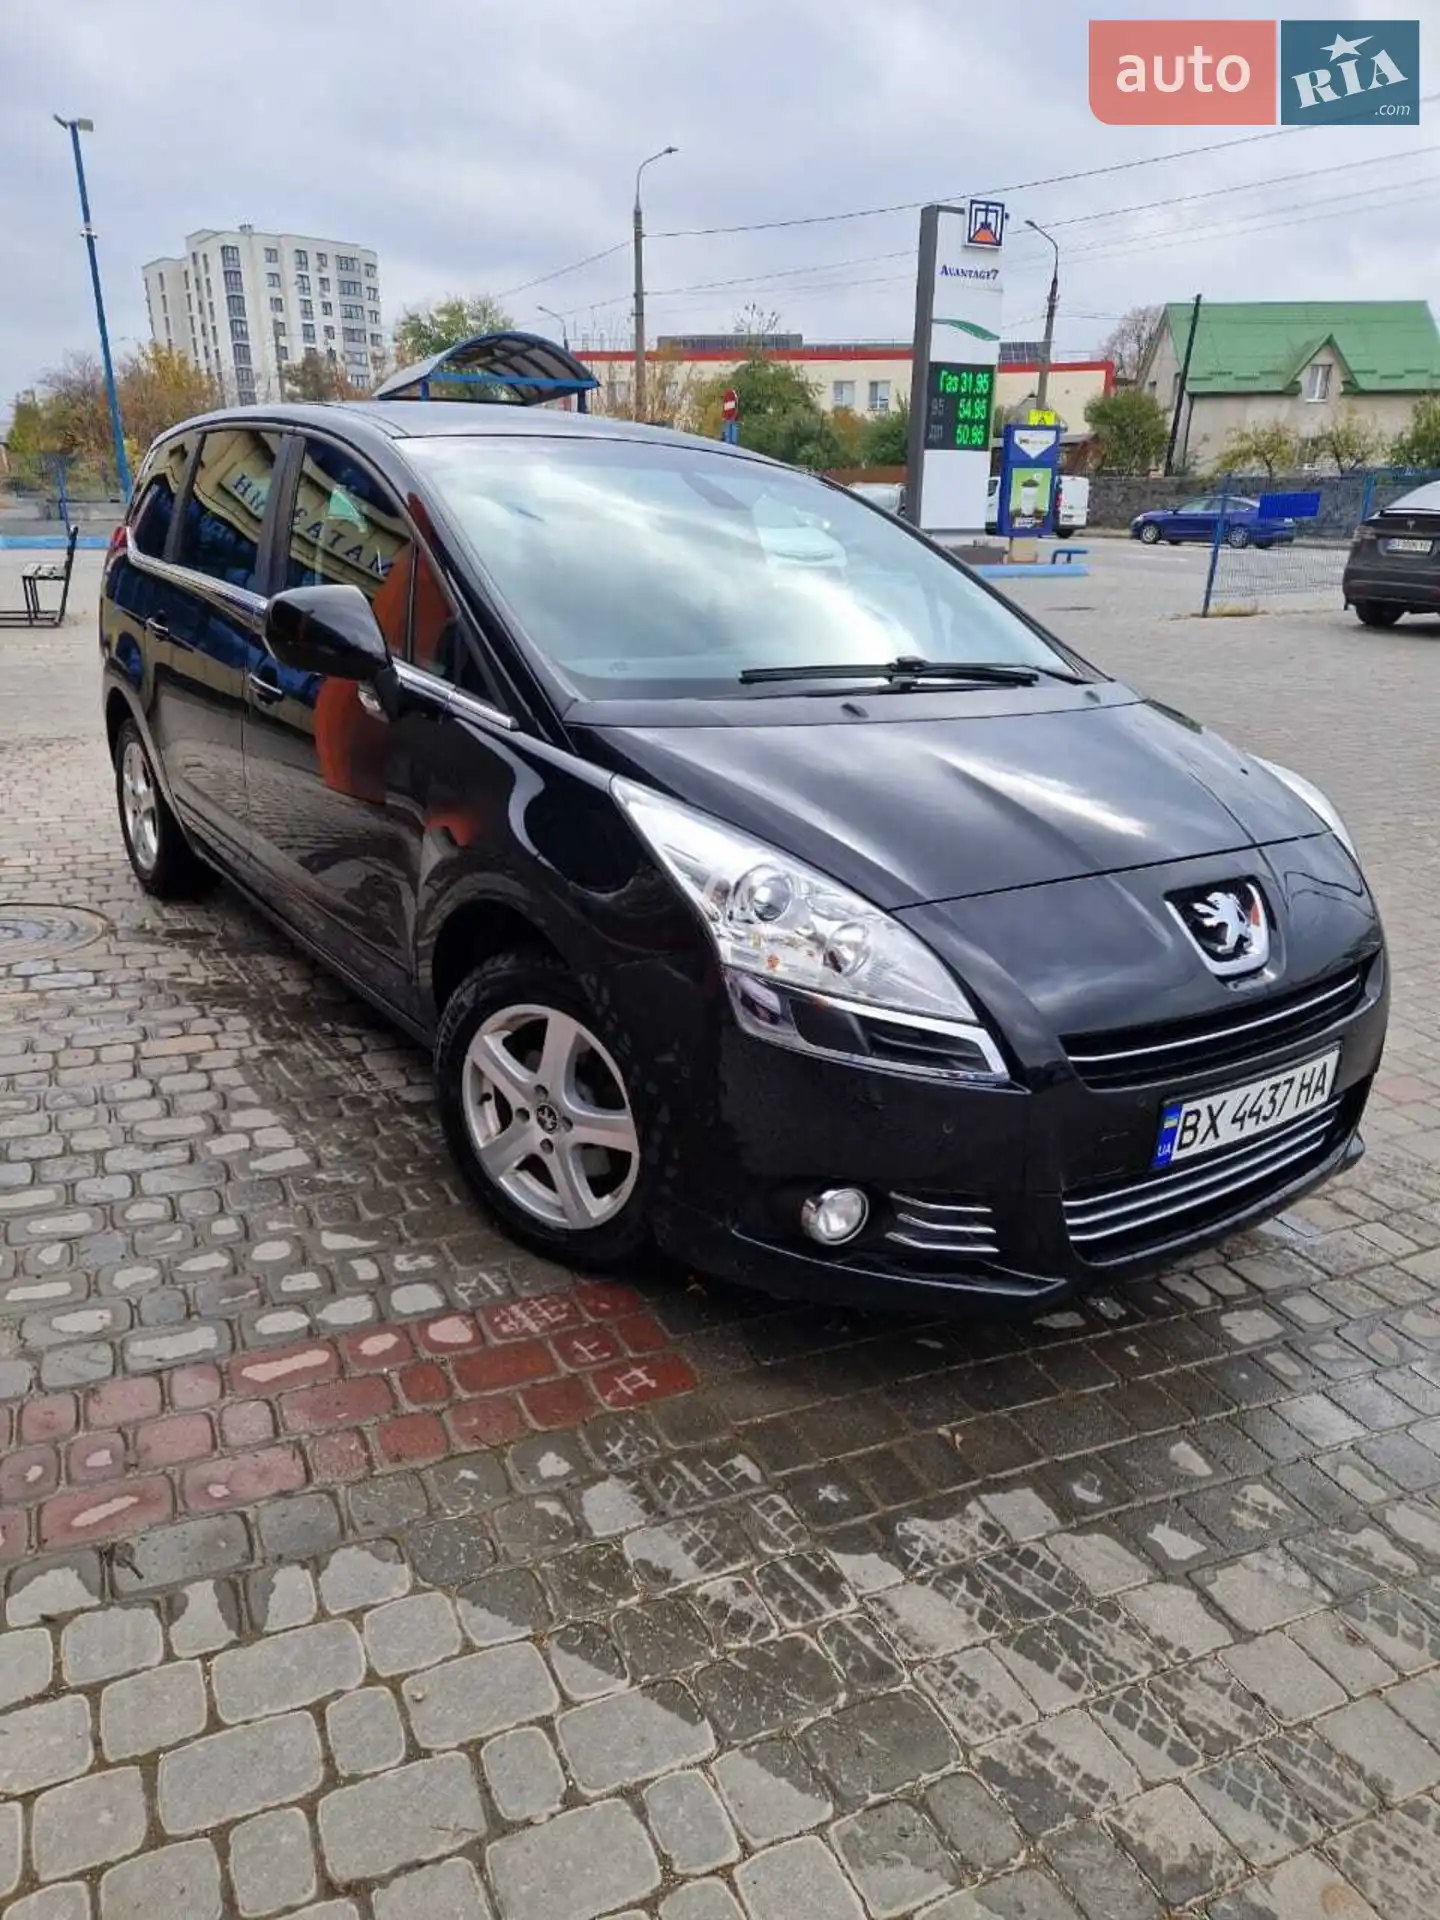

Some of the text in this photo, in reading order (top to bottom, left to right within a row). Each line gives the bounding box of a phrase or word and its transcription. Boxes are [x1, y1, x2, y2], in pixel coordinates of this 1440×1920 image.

[940, 370, 990, 395] Газ 31.95
[959, 398, 988, 420] 54.95
[956, 423, 985, 445] 50.95
[1177, 1062, 1327, 1151] BX 4437 HA
